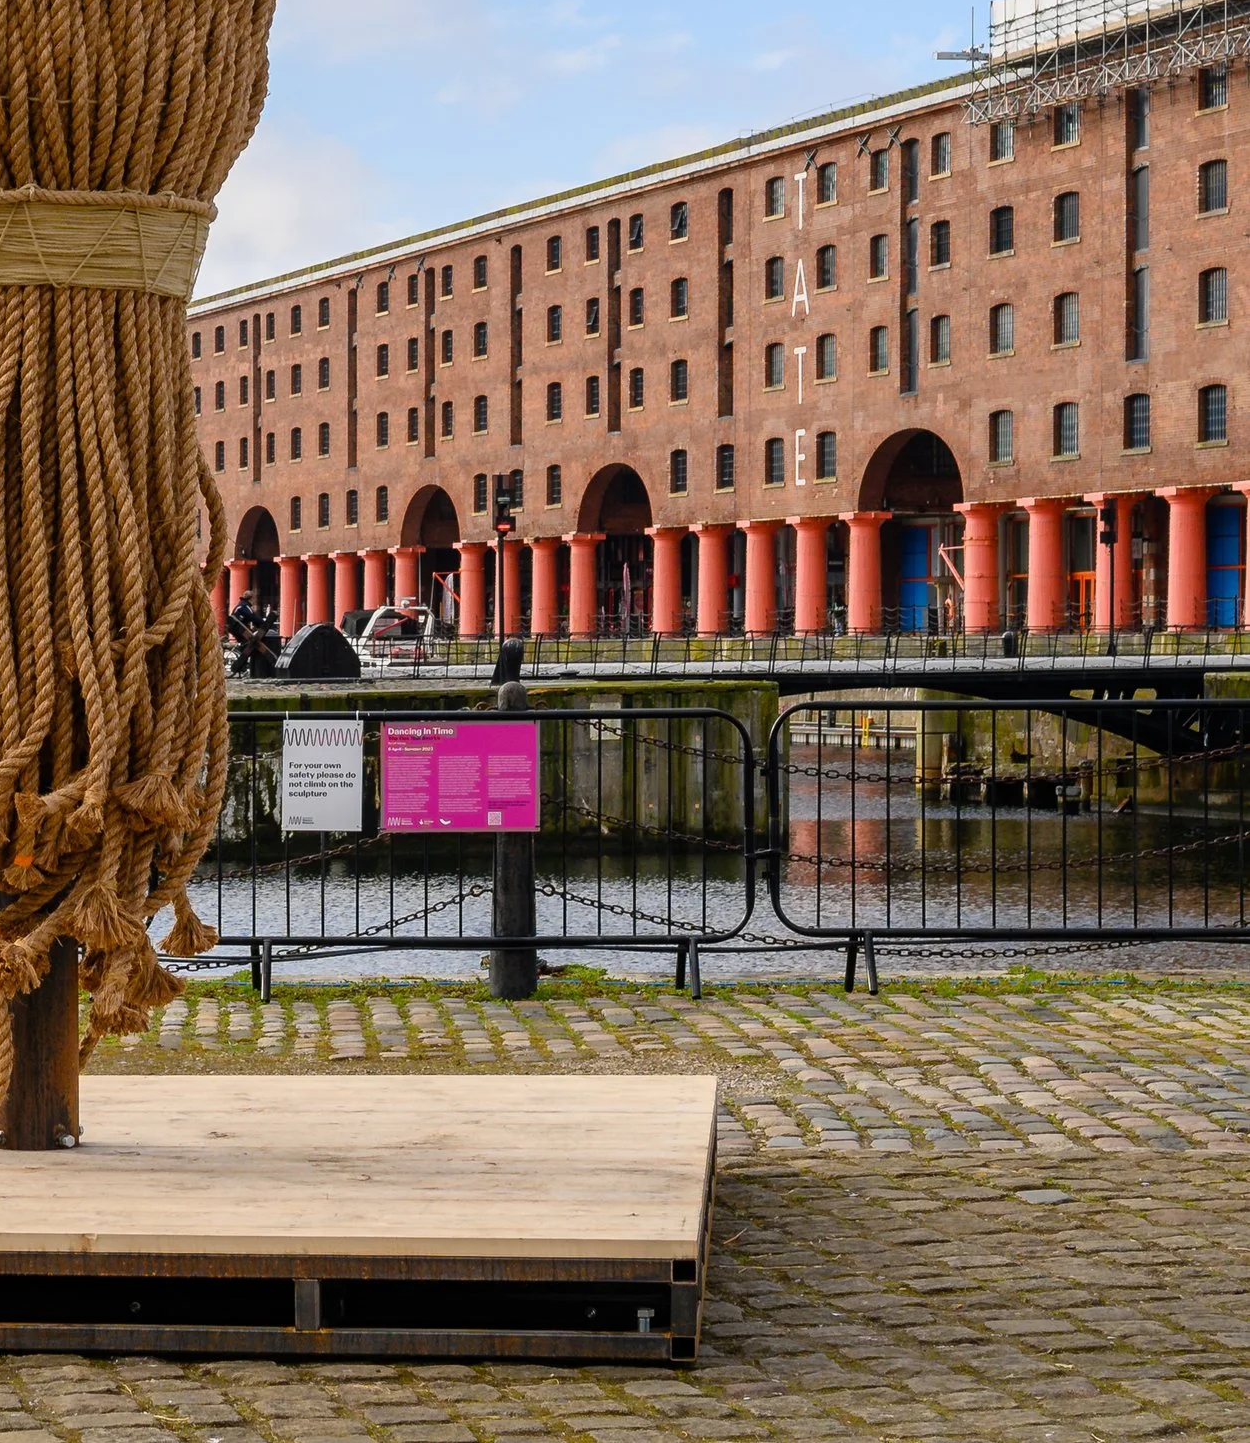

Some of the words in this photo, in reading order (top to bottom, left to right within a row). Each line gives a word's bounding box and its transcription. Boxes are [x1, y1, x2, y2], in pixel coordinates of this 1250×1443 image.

[791, 172, 809, 486] TATE
[387, 727, 422, 737] Dancing
[423, 727, 432, 735] In
[432, 727, 454, 735] Time
[289, 761, 302, 769] For
[288, 771, 315, 779] safety
[316, 771, 344, 779] please
[345, 771, 357, 779] do
[288, 790, 328, 798] sculpture
